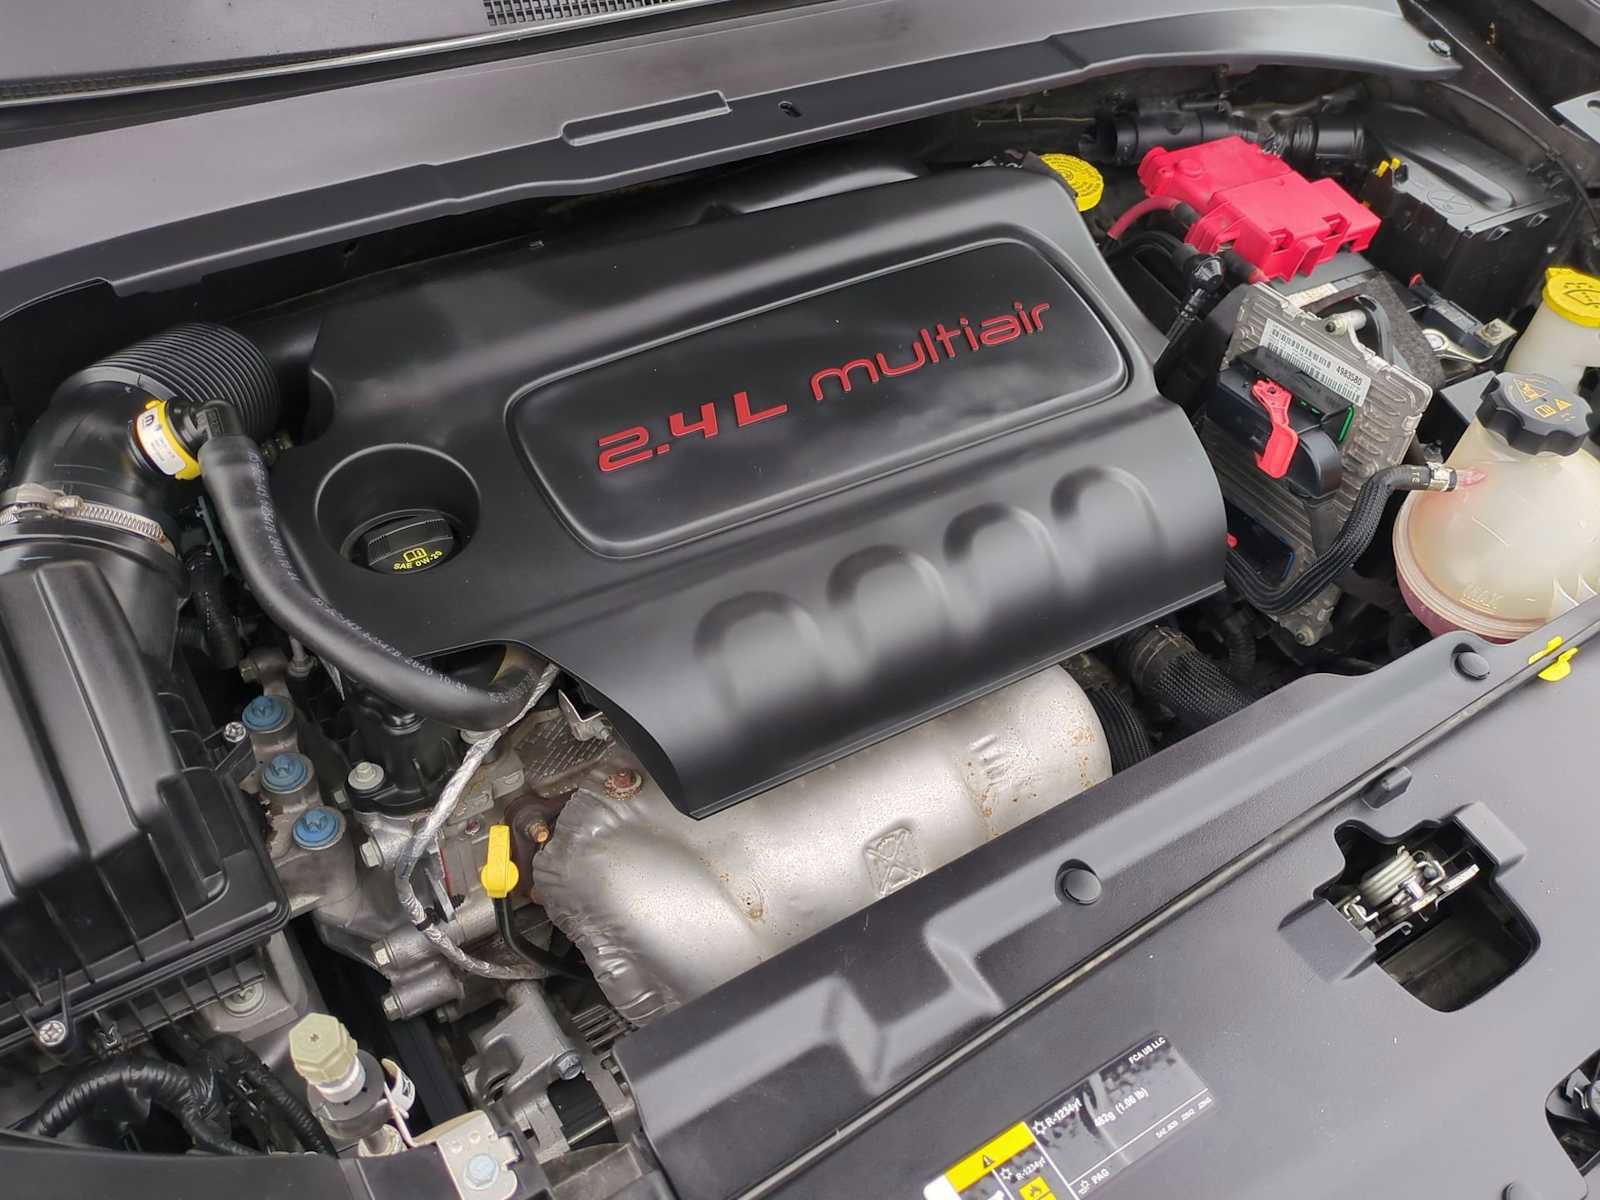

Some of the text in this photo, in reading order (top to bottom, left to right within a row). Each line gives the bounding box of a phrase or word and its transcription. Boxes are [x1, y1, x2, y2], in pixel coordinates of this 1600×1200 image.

[810, 301, 1051, 401] multiair
[393, 550, 442, 571] SAE 0W-20
[1128, 1050, 1145, 1064] FCA
[1151, 1036, 1167, 1050] LLC
[1044, 1097, 1084, 1128] R-1234yf
[1015, 1155, 1047, 1182] R-1234yf
[1090, 1168, 1110, 1186] PAG
